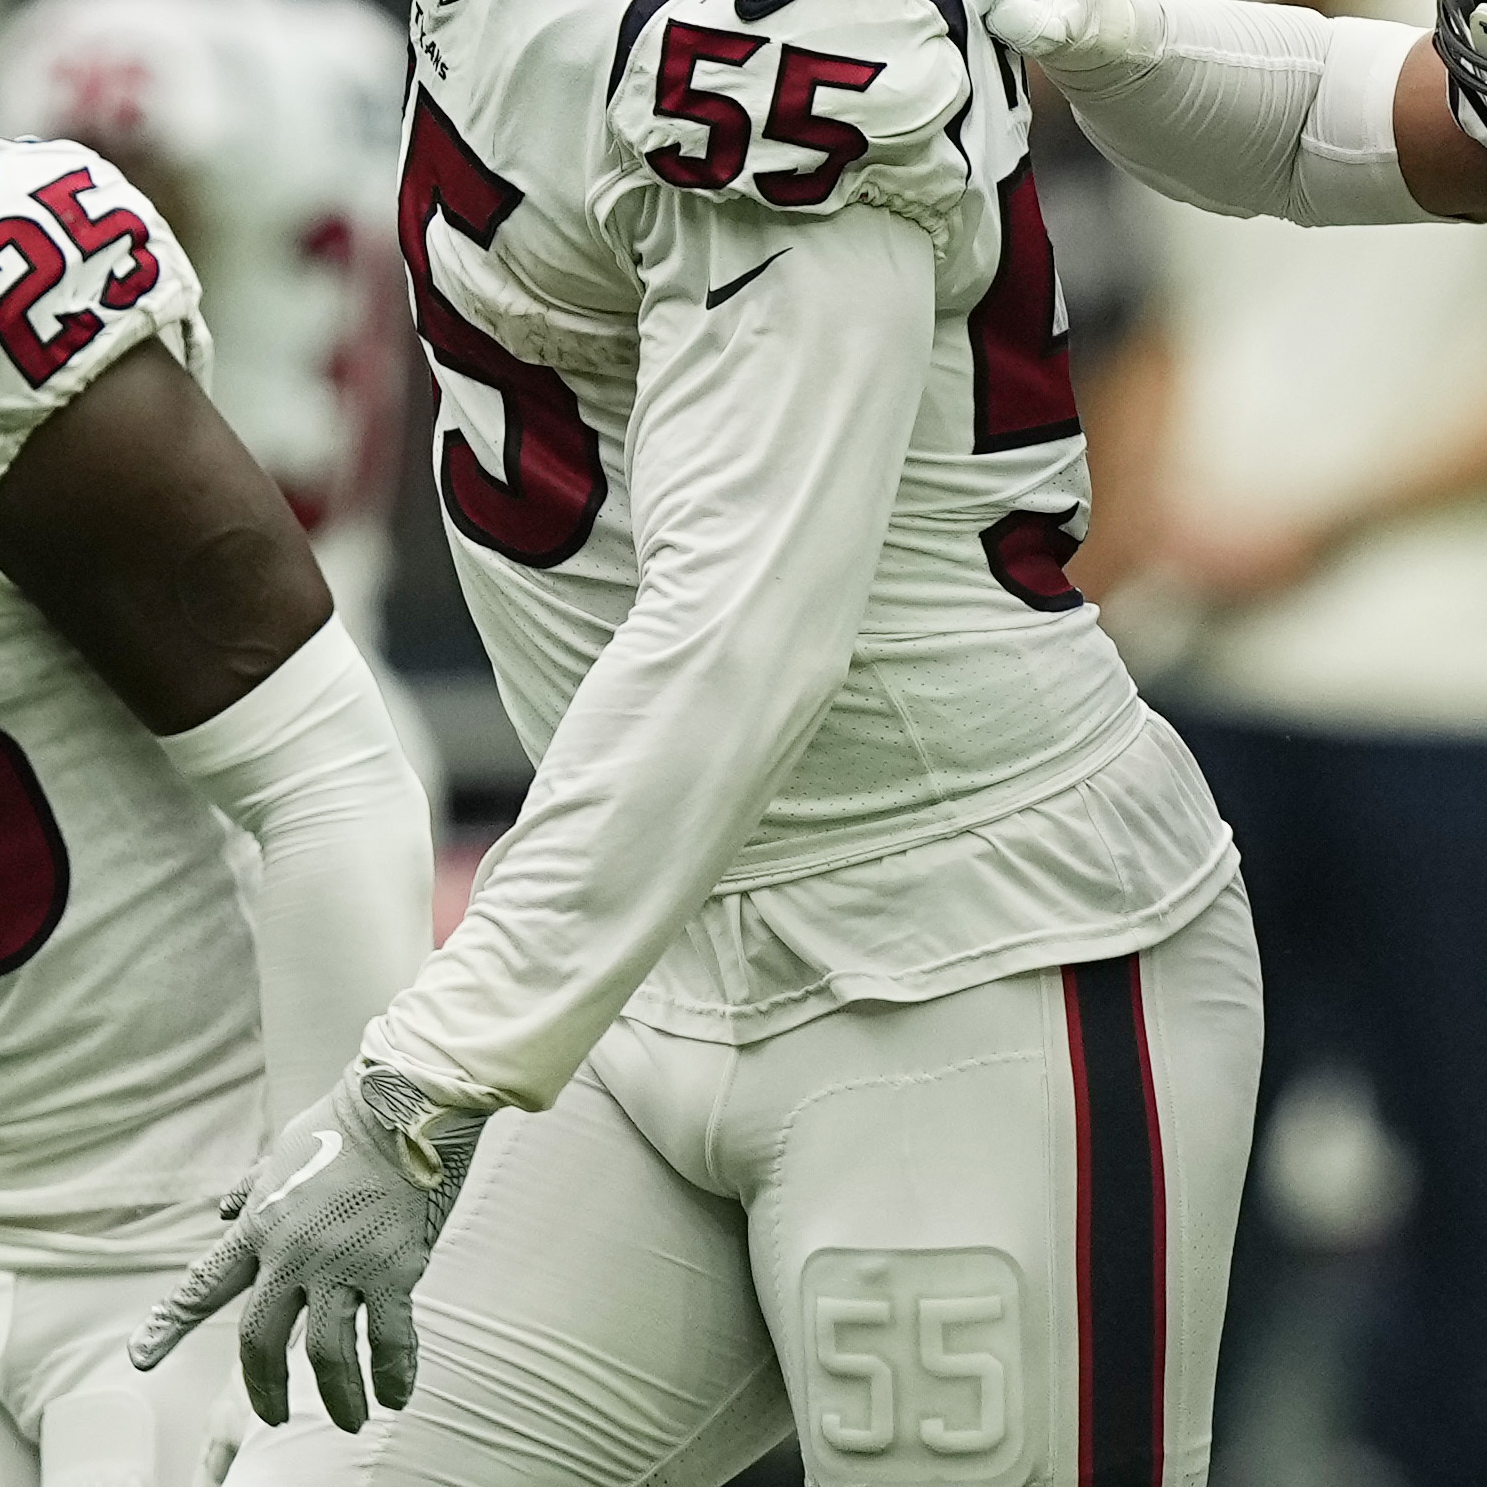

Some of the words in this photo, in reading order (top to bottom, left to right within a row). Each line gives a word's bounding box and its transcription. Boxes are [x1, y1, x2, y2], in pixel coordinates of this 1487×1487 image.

[415, 1, 448, 80] TANS
[644, 17, 888, 208] 55
[399, 83, 608, 570] 5
[815, 1295, 1006, 1457] 55
